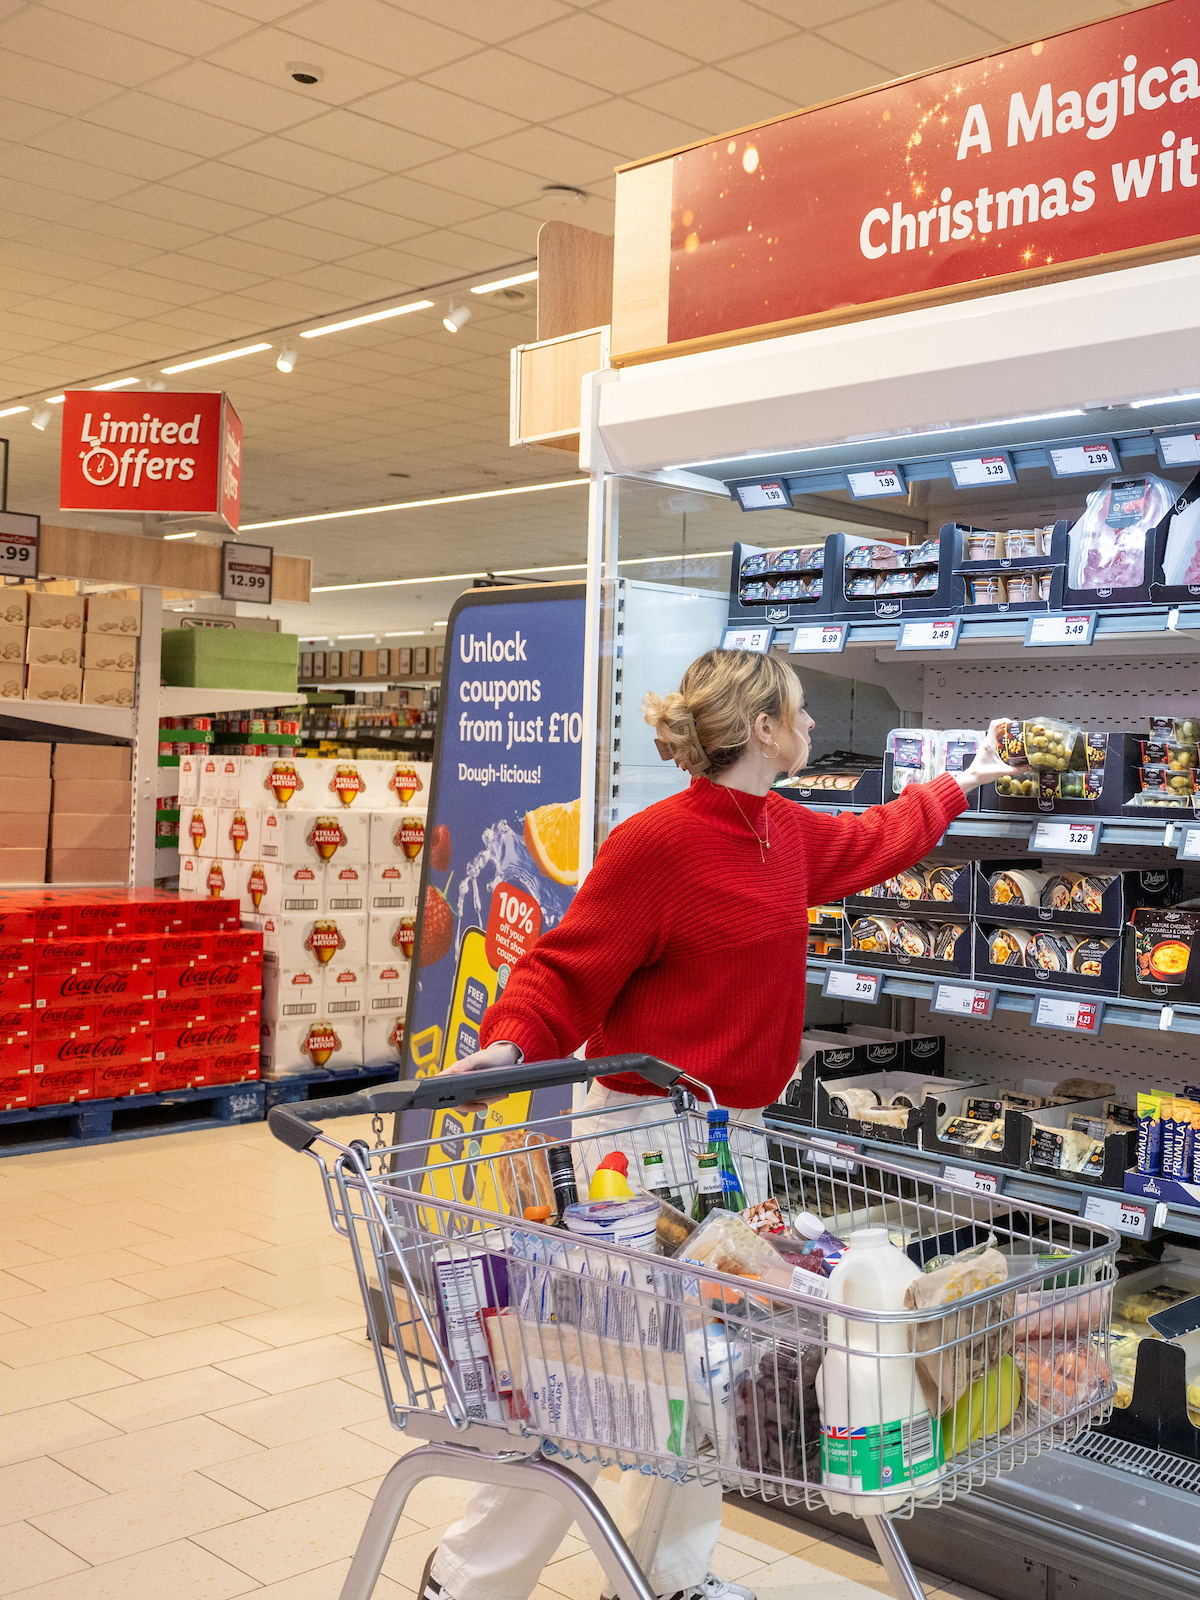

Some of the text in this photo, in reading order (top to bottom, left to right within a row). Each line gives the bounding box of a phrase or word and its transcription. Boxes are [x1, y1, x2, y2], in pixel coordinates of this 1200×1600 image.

[956, 103, 994, 161] A
[859, 169, 1096, 260] Christmas
[81, 412, 201, 445] Limited
[79, 440, 195, 487] Offers
[1088, 453, 1108, 465] 2.99
[986, 465, 1004, 475] 3.29
[879, 477, 895, 488] 1.99
[230, 573, 265, 588] 12.99
[932, 629, 949, 640] 2.49
[1065, 624, 1083, 636] 3.49
[822, 633, 838, 643] 6.99
[460, 631, 527, 663] Unlock
[459, 679, 541, 710] coupons
[459, 712, 582, 750] from just £10
[458, 763, 541, 787] Dough-licious!
[1069, 833, 1088, 844] 3.29
[499, 892, 534, 934] 10%
[495, 934, 510, 948] next
[499, 924, 525, 943] off your
[467, 986, 485, 1002] FREE
[856, 983, 872, 993] 2.99
[1079, 1015, 1091, 1025] 4.23
[460, 1031, 477, 1049] FREE
[490, 1110, 504, 1125] £50
[1138, 1121, 1149, 1171] PRIMULA
[1121, 1212, 1140, 1226] 2.19
